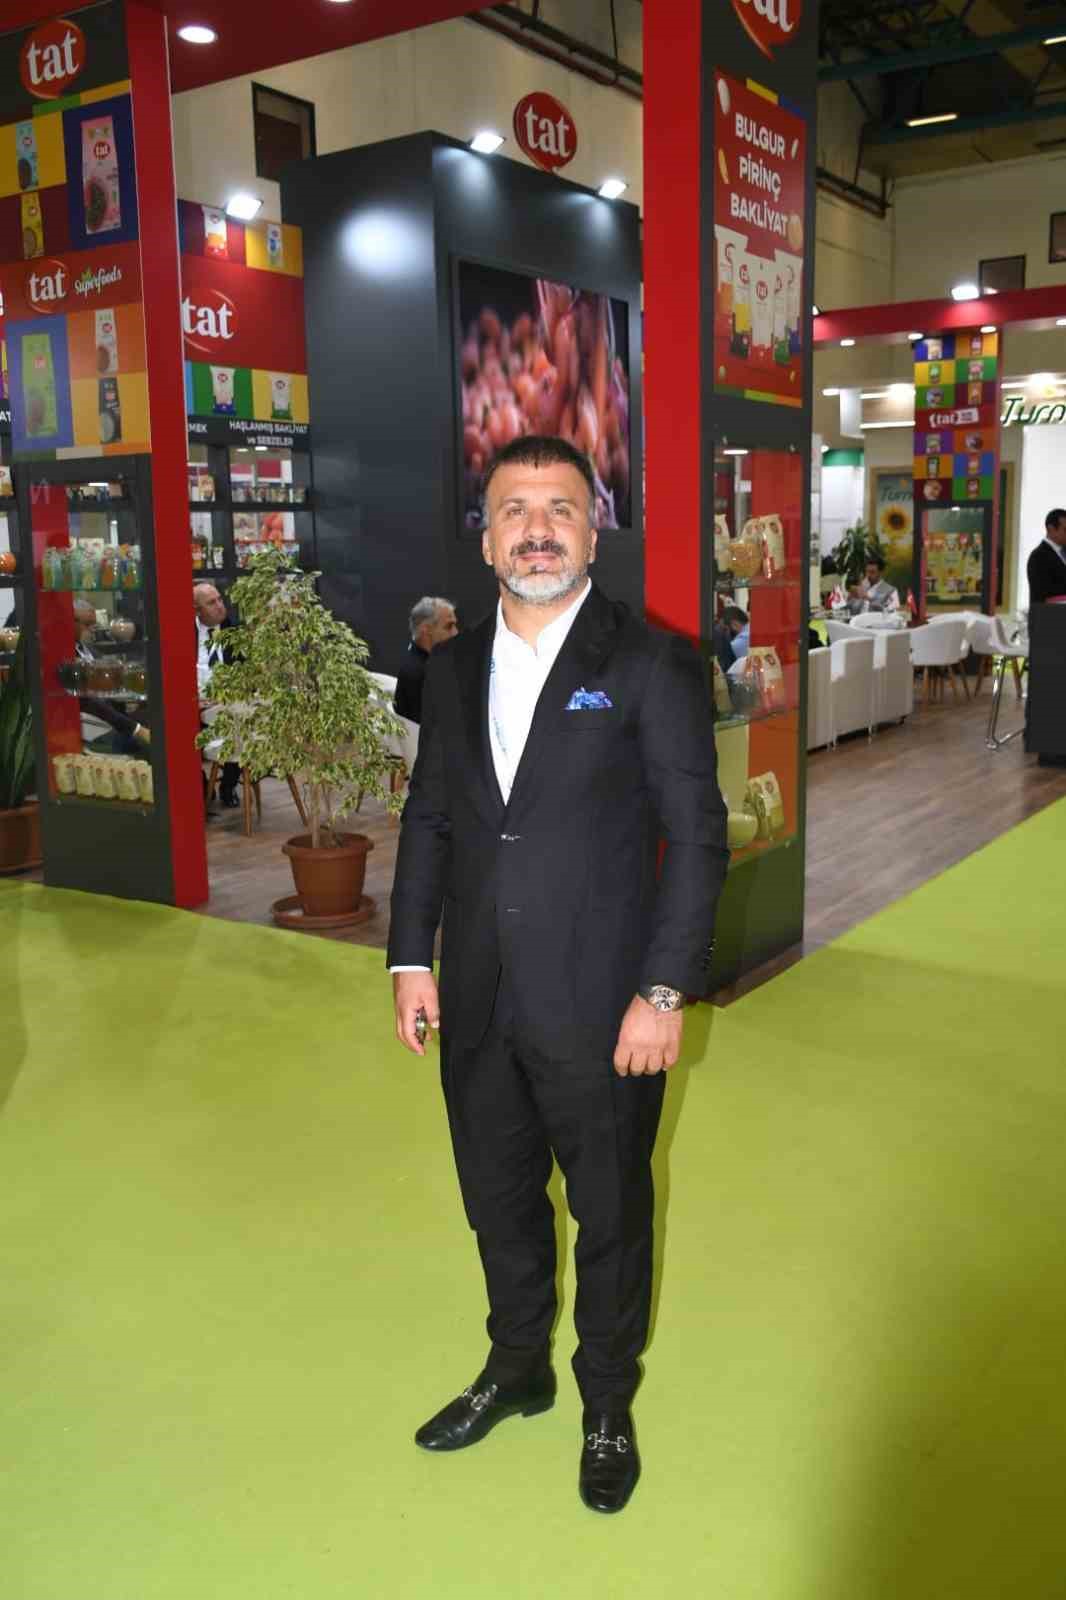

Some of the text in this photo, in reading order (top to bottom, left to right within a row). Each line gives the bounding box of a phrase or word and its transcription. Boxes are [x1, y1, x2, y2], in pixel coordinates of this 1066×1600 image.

[26, 29, 79, 85] tat
[525, 104, 570, 157] tat
[735, 112, 786, 159] BULGUR
[739, 152, 781, 201] PİRİNÇ
[730, 193, 787, 238] BAKLİYAT
[29, 267, 66, 302] tat
[182, 297, 234, 339] tat
[1002, 396, 1066, 425] Turn
